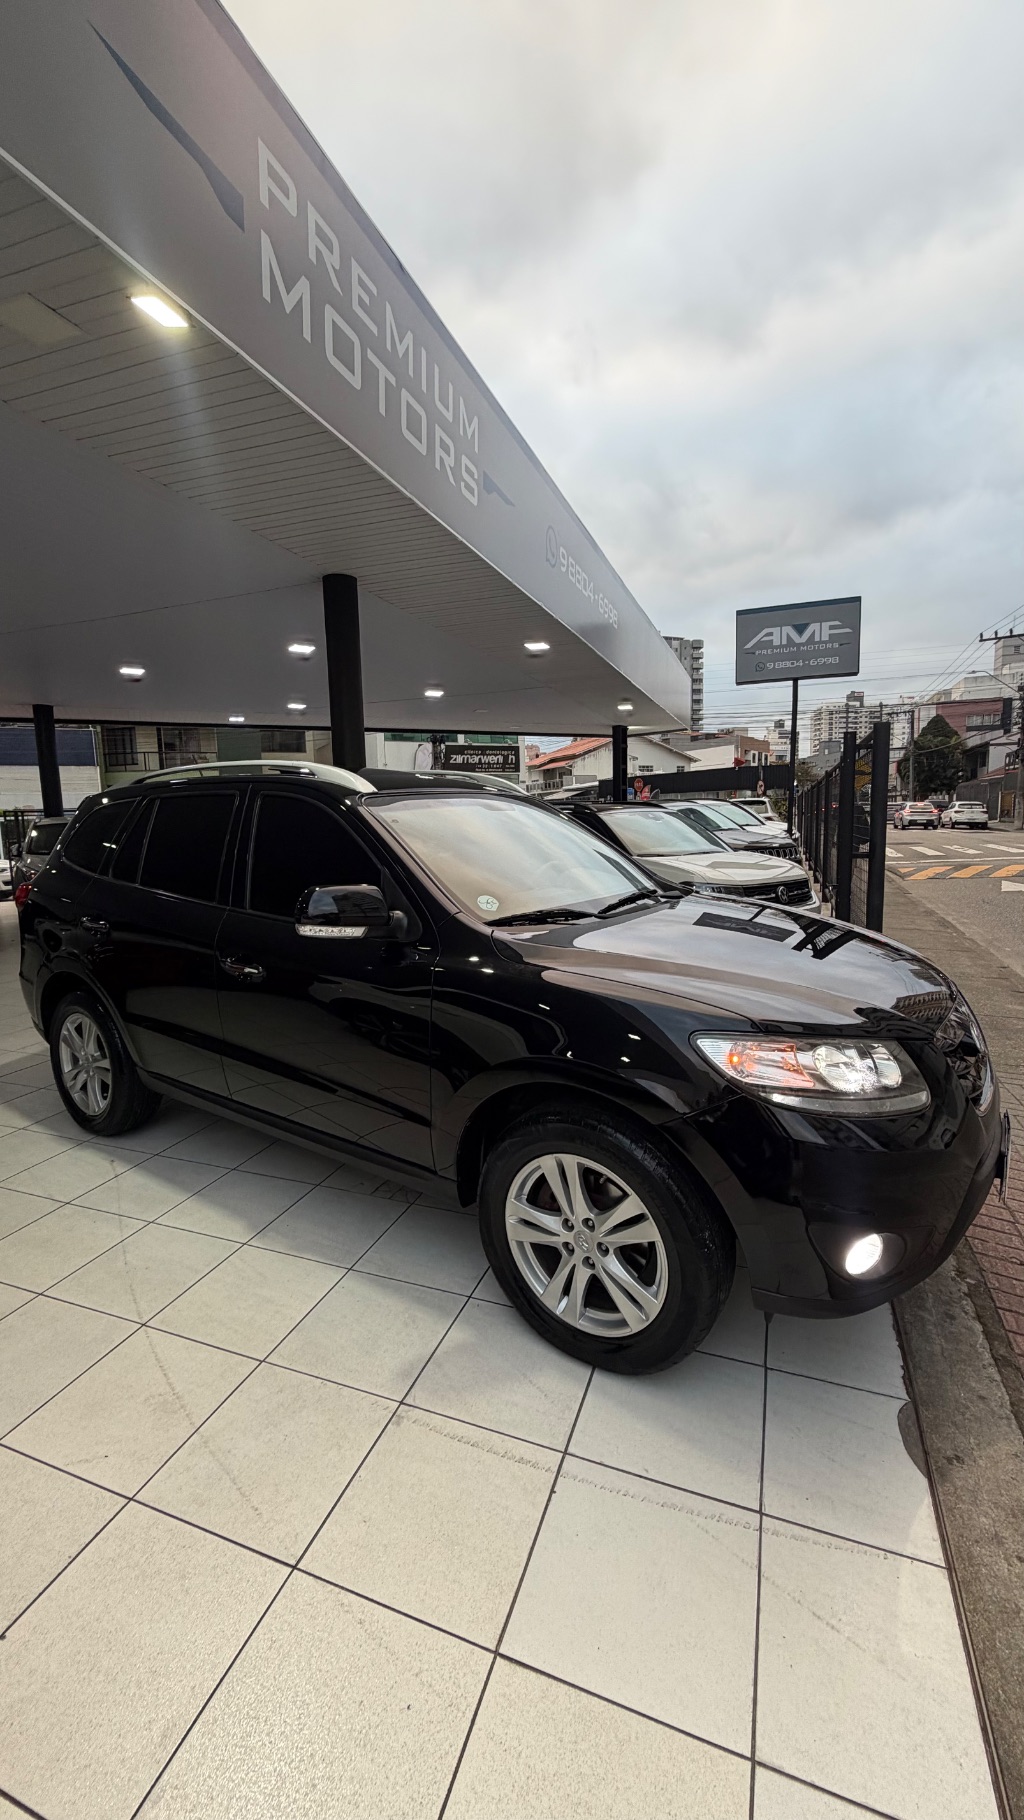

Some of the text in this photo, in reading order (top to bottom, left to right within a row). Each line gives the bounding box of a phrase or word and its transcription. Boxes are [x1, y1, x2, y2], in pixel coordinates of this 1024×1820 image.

[258, 137, 479, 454] PREMIUM
[261, 229, 479, 507] MOTORS
[743, 620, 853, 649] AMF
[755, 643, 839, 655] PREMIUM MOTORS
